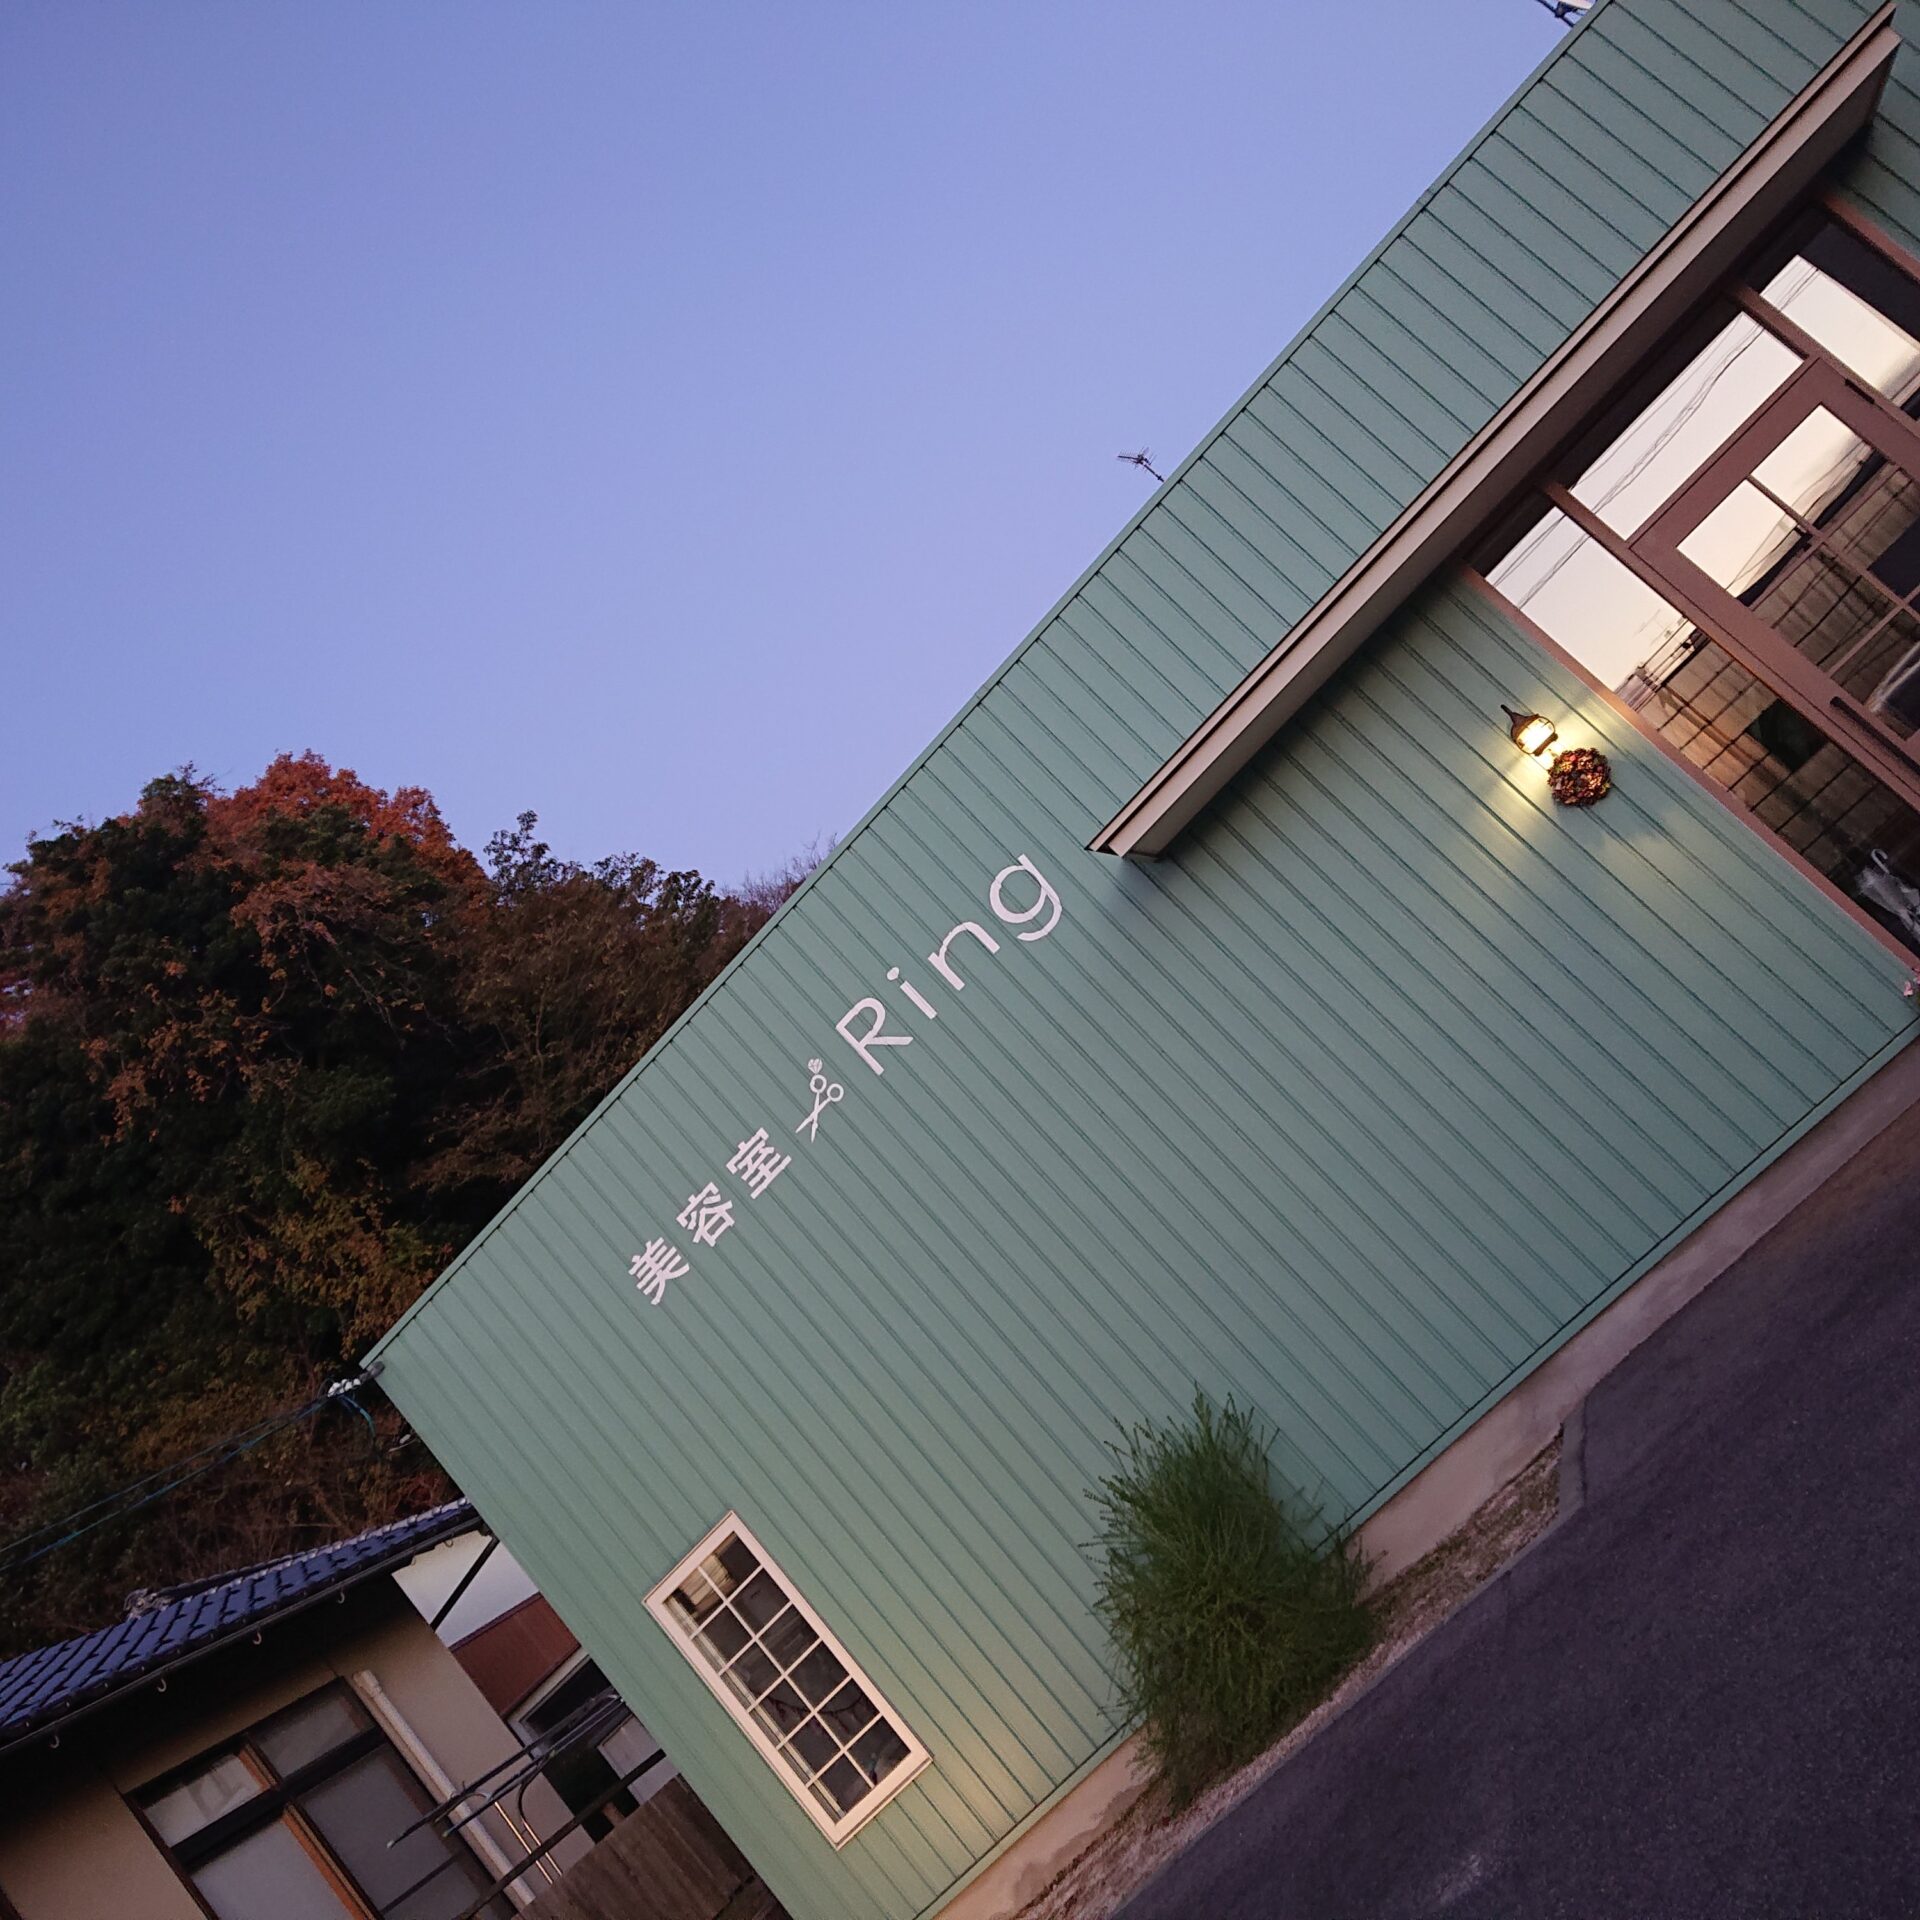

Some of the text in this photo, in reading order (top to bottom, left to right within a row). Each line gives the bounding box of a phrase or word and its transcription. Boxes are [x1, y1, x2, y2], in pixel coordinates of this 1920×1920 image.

[628, 853, 1063, 1306] 美容室 Ring
